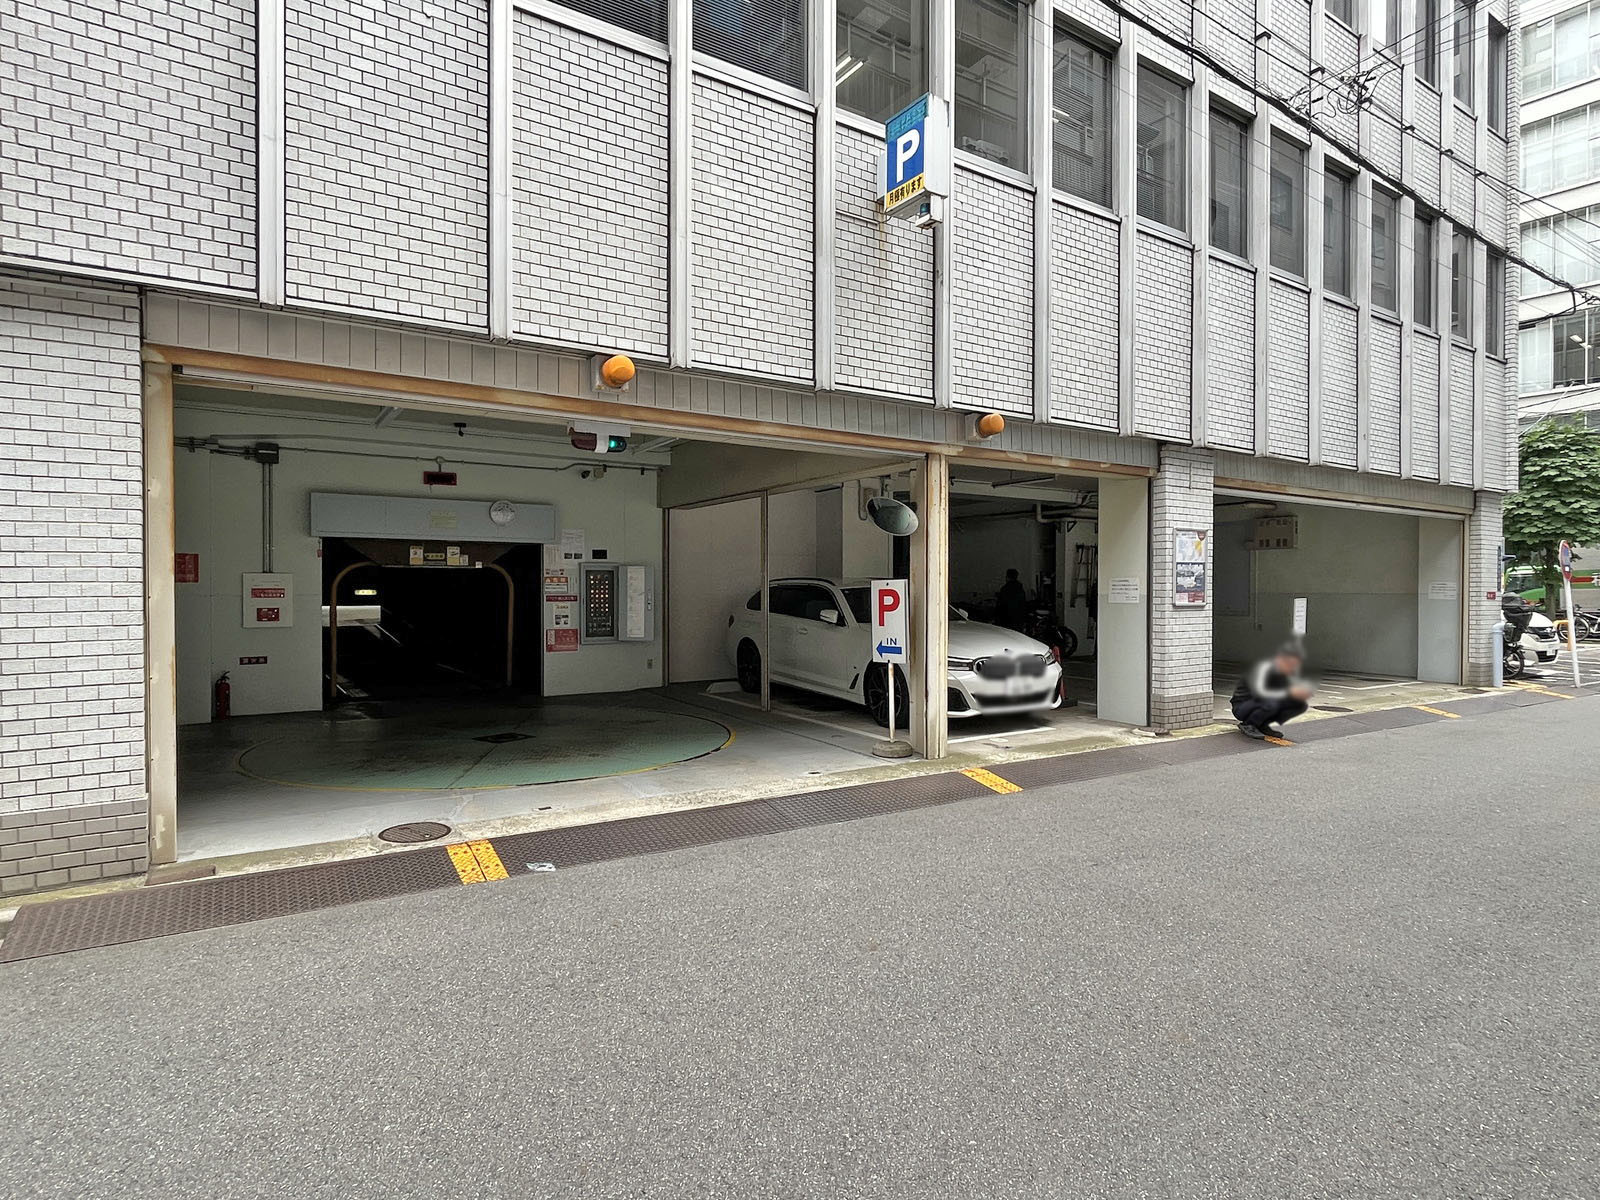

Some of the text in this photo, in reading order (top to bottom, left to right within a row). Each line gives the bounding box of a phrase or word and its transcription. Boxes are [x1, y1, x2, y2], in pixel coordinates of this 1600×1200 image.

[896, 129, 920, 183] P
[879, 588, 900, 626] P
[886, 638, 897, 646] IN
